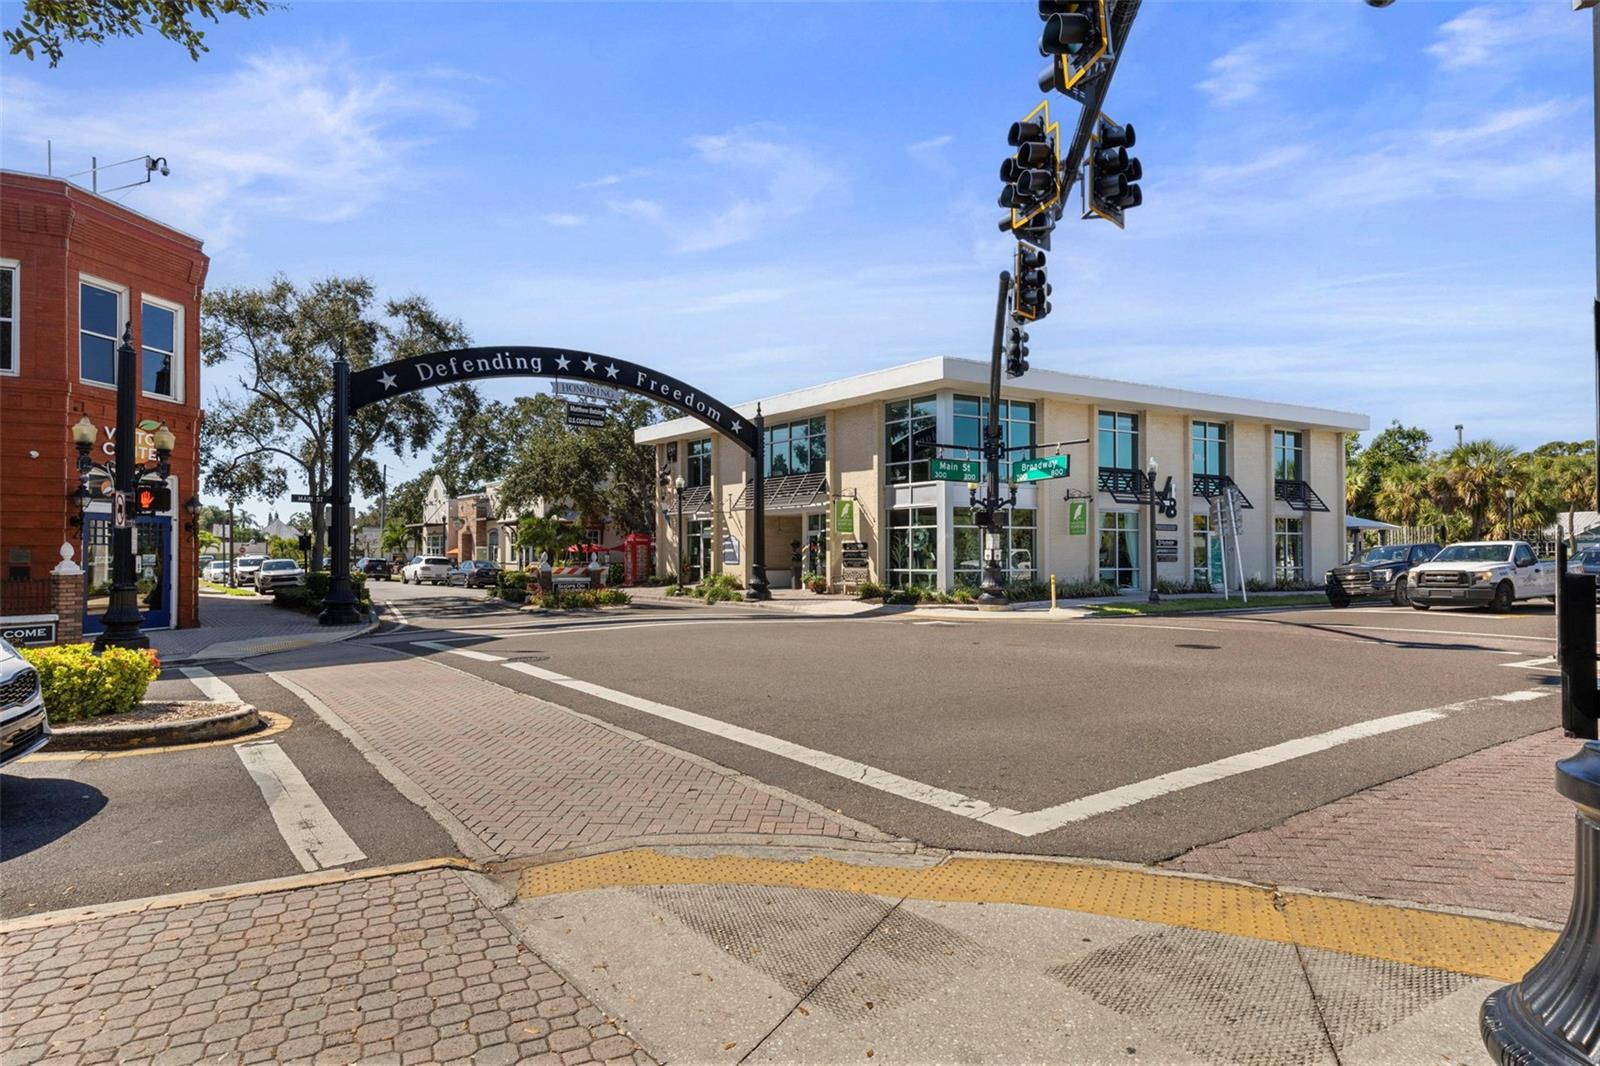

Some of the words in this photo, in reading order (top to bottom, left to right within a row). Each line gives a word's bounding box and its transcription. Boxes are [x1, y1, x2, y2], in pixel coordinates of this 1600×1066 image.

[415, 352, 542, 381] Defending
[636, 371, 721, 423] Freedom
[561, 383, 615, 398] HONORING
[939, 461, 958, 471] Main
[962, 463, 971, 472] St
[1021, 460, 1058, 472] Broadway
[934, 471, 947, 479] 300
[963, 473, 976, 481] 200
